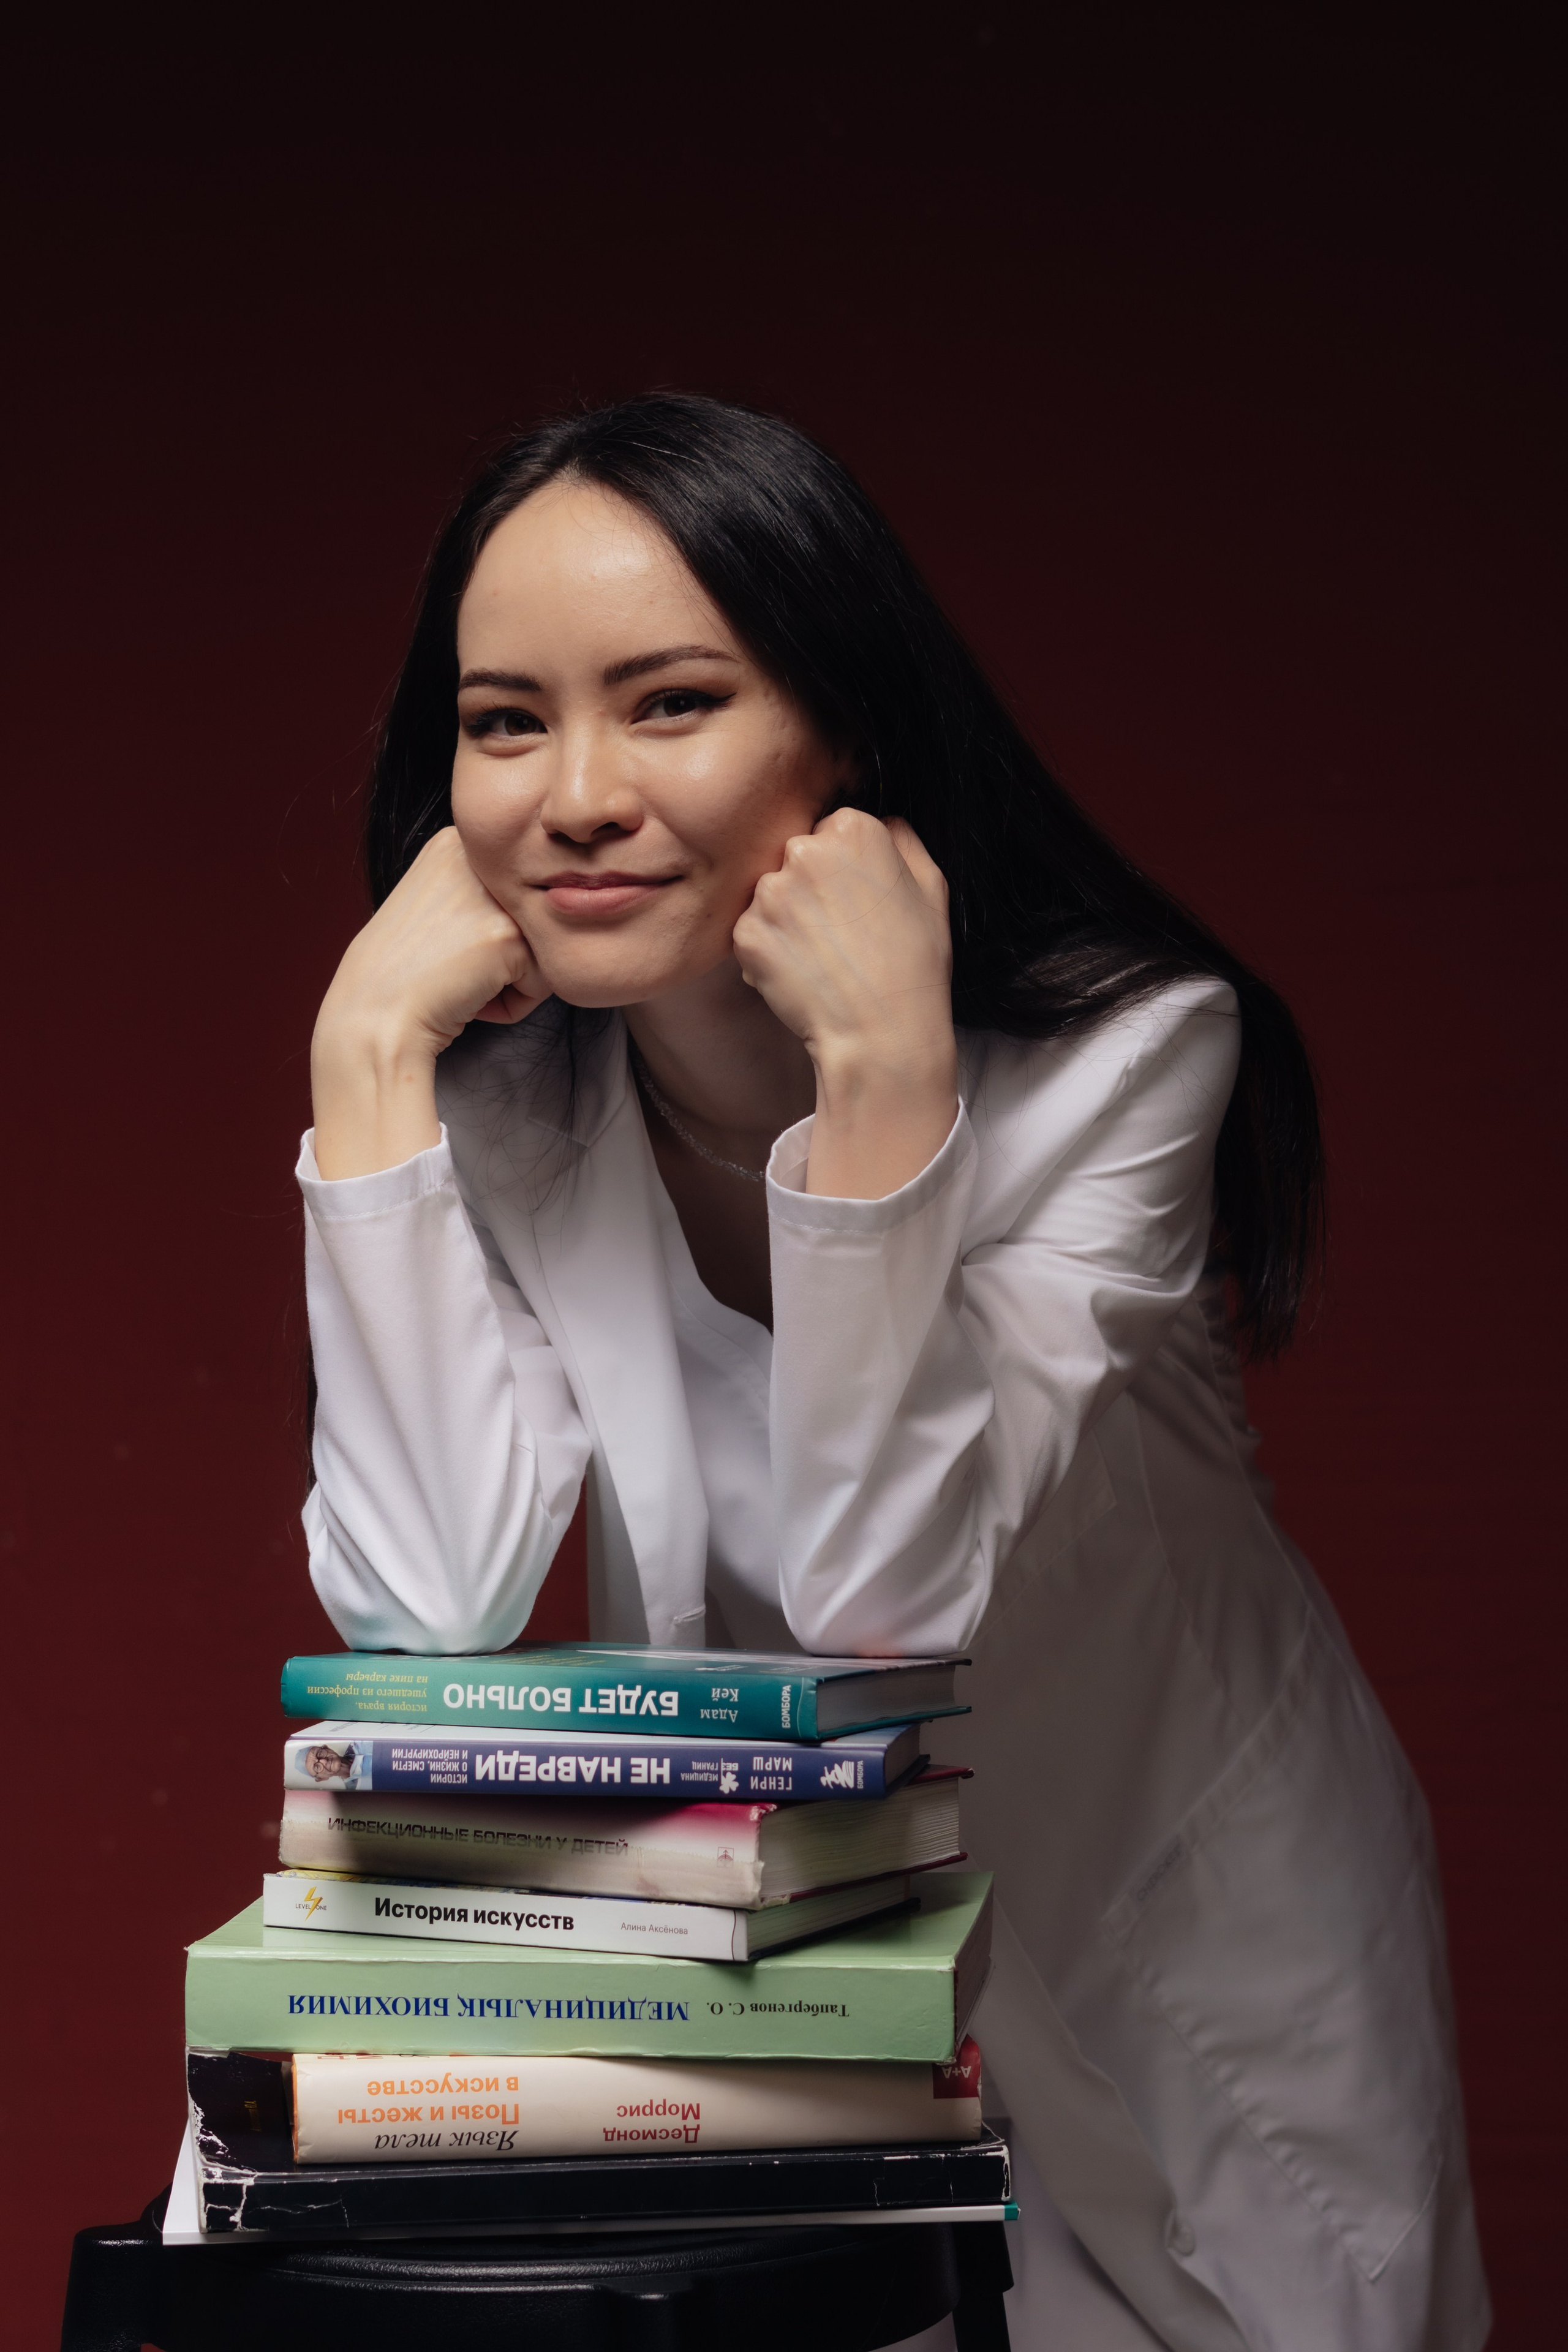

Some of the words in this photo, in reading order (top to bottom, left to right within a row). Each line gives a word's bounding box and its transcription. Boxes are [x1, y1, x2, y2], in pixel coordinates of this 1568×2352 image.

[345, 1672, 387, 1683] карьеры
[390, 1675, 413, 1683] пике
[307, 1686, 360, 1697] профессии
[376, 1688, 428, 1698] ушедшего
[443, 1683, 571, 1713] БОЛЬНО
[711, 1687, 739, 1702] Кей
[388, 1702, 428, 1712] история
[578, 1684, 679, 1716] БУДЕТ
[781, 1684, 791, 1729] БОМБОРА
[699, 1708, 739, 1723] Адам
[391, 1748, 460, 1762] НЕЙРОХИРУРГИИ
[461, 1749, 468, 1759] И
[392, 1760, 424, 1771] СМЕРТИ
[427, 1758, 460, 1771] ЖИЗНИ,
[461, 1762, 468, 1771] О
[475, 1750, 622, 1784] НАВРЕДИ
[630, 1757, 671, 1784] НЕ
[692, 1760, 718, 1771] ГРАНИЦ
[721, 1762, 739, 1771] БЕЗ
[753, 1756, 792, 1771] МАРШ
[430, 1773, 468, 1784] ИСТОРИИ
[680, 1772, 718, 1782] МЕДИЦИНА
[750, 1776, 792, 1791] ГЕНРИ
[328, 1817, 469, 1843] ИНФЕКЦИОННЫЕ
[473, 1829, 551, 1848] БОЛЕЗНИ
[556, 1837, 567, 1850] У
[571, 1839, 628, 1856] ДЕТЕЙ
[375, 1897, 468, 1924] История
[473, 1909, 575, 1931] искусств
[620, 1922, 647, 1932] Алина
[649, 1924, 688, 1935] Аксёнова
[287, 1994, 450, 2016] БИОХИМИЯ
[456, 1993, 690, 2021] МЕДИЦИНАЛЫҚ
[706, 2002, 723, 2015] О.
[728, 2002, 745, 2016] С.
[750, 2000, 850, 2017] Тапбергенов
[367, 2072, 500, 2096] искусстве
[506, 2076, 519, 2091] в
[337, 2106, 423, 2124] жесты
[431, 2106, 443, 2121] и
[451, 2103, 519, 2125] Позы
[616, 2098, 701, 2121] Моррис
[374, 2132, 441, 2150] тела
[448, 2130, 520, 2152] Язык
[603, 2124, 701, 2144] Десмонд
